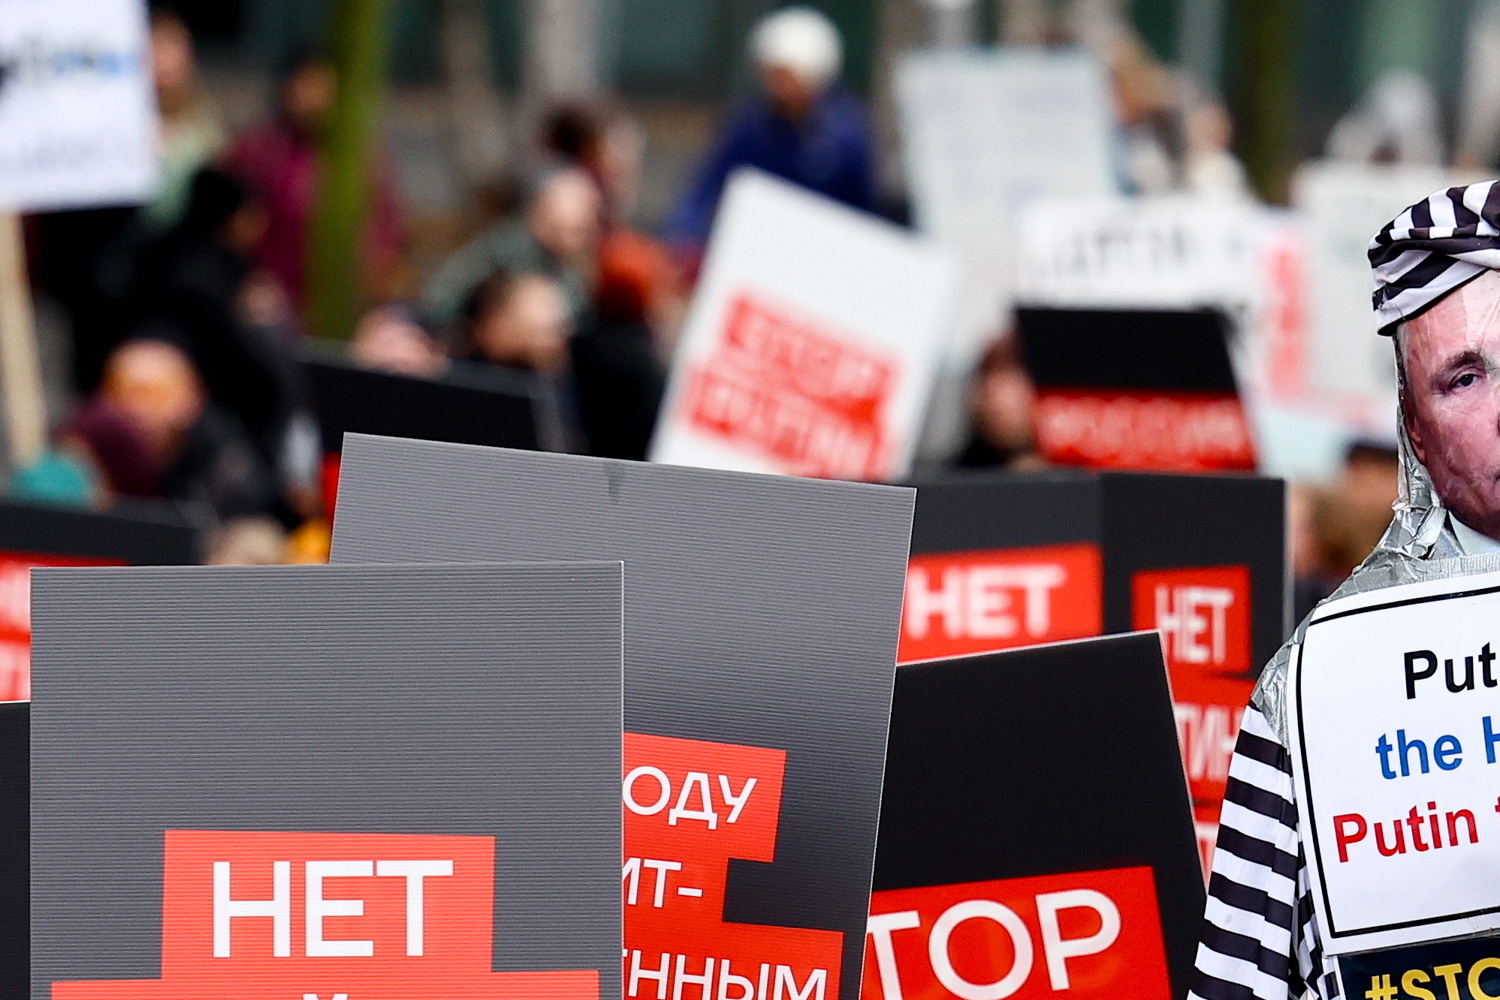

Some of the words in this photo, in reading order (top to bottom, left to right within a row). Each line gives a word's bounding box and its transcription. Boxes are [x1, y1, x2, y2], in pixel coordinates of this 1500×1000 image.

[906, 563, 1069, 639] НЕТ
[1155, 585, 1234, 664] НЕТ
[1375, 728, 1463, 780] the
[1332, 801, 1479, 863] Putin
[213, 859, 454, 958] НЕТ
